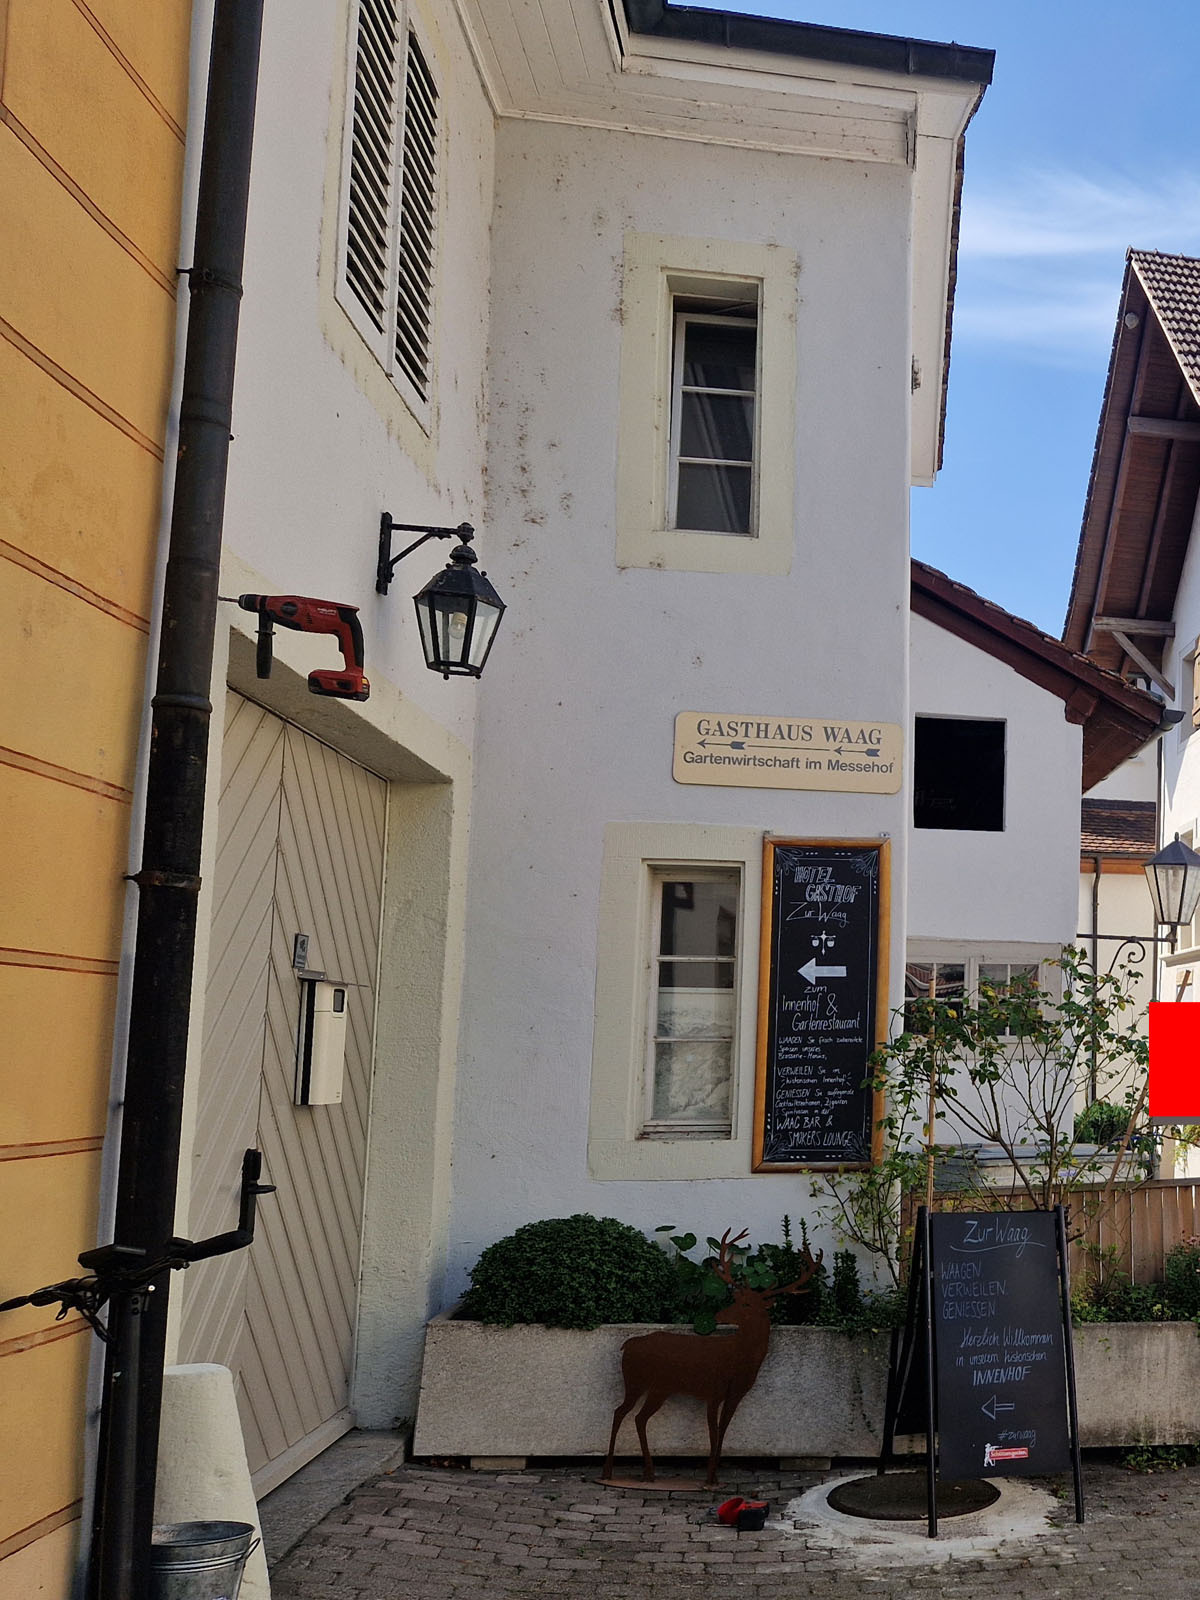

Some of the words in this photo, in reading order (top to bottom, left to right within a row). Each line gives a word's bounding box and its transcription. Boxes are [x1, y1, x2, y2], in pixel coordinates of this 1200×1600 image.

[696, 718, 813, 742] GASTHAUS
[822, 726, 882, 745] WAAG
[683, 751, 801, 769] Gartenwirtschaft
[805, 758, 822, 770] im
[827, 759, 894, 774] Messehof
[793, 866, 835, 883] HOTEL
[805, 883, 862, 903] GASTHOF
[786, 901, 815, 921] Zur
[818, 901, 850, 928] Waag
[804, 985, 827, 993] zum
[782, 993, 822, 1018] Innenhof
[826, 993, 838, 1016] &
[792, 1011, 860, 1031] Gartenrestaurant
[777, 1066, 813, 1076] VERWEILEN
[776, 1088, 811, 1099] GENIESSEN
[776, 1115, 800, 1130] WAAG
[803, 1116, 821, 1128] BAR
[825, 1114, 833, 1127] &
[788, 1131, 821, 1147] SMOKERS
[823, 1131, 854, 1147] LOUNGE
[963, 1220, 993, 1243] Zur
[995, 1216, 1032, 1258] Waag
[942, 1298, 997, 1320] GENIESSEN
[960, 1327, 1000, 1348] Herzlich
[1003, 1326, 1053, 1346] Willkommen
[956, 1353, 964, 1367] in
[969, 1353, 999, 1366] unserem
[1004, 1350, 1047, 1366] historischen
[973, 1366, 1032, 1386] INNENHOF
